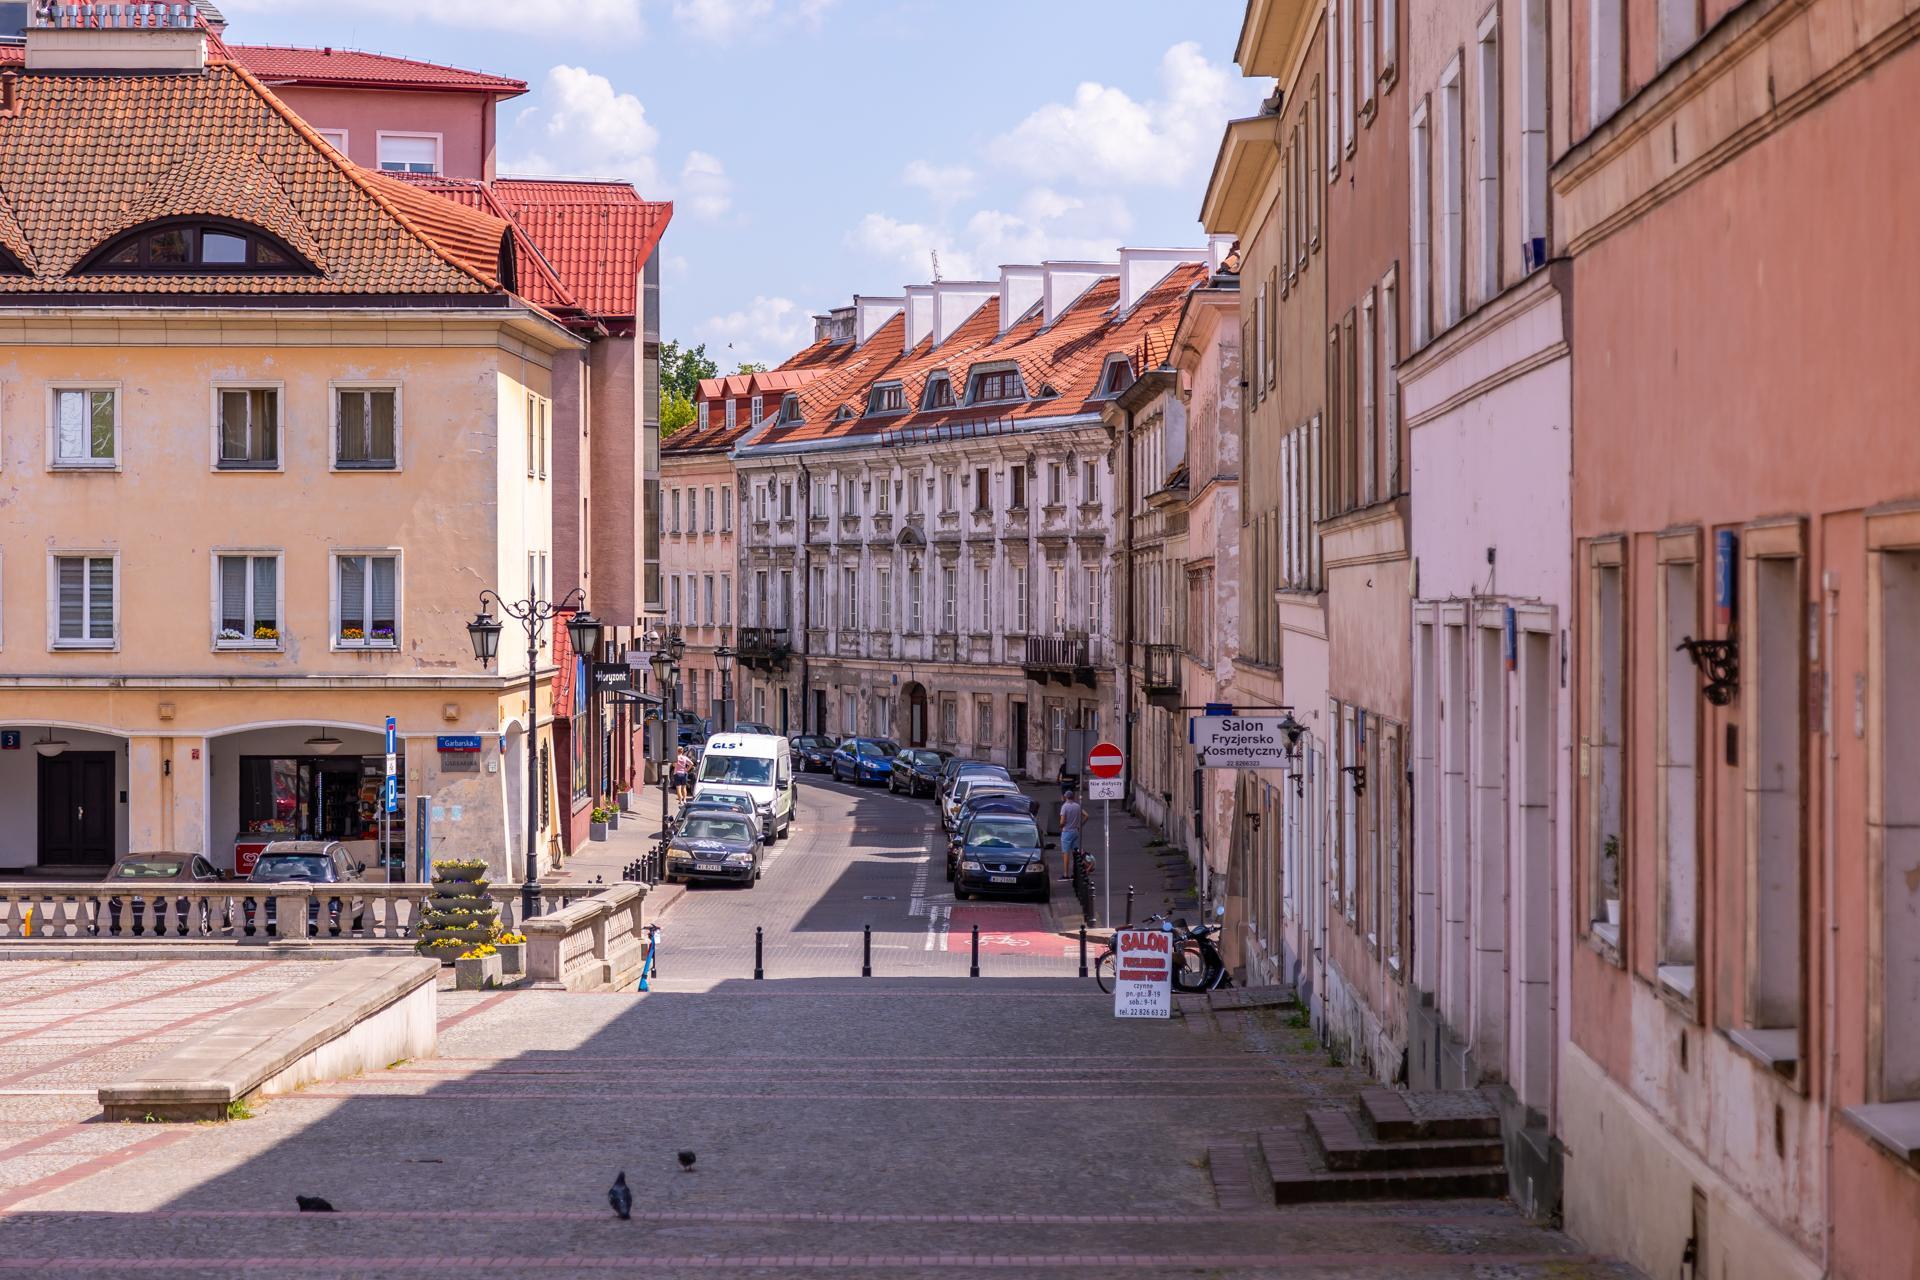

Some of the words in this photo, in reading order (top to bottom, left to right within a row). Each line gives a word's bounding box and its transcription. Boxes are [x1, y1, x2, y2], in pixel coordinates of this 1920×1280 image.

[1222, 719, 1264, 731] Salon
[7, 735, 14, 745] 3
[1212, 733, 1274, 746] Fryzjersko
[1203, 745, 1283, 758] Kosmetyczny
[1121, 932, 1169, 953] SALON
